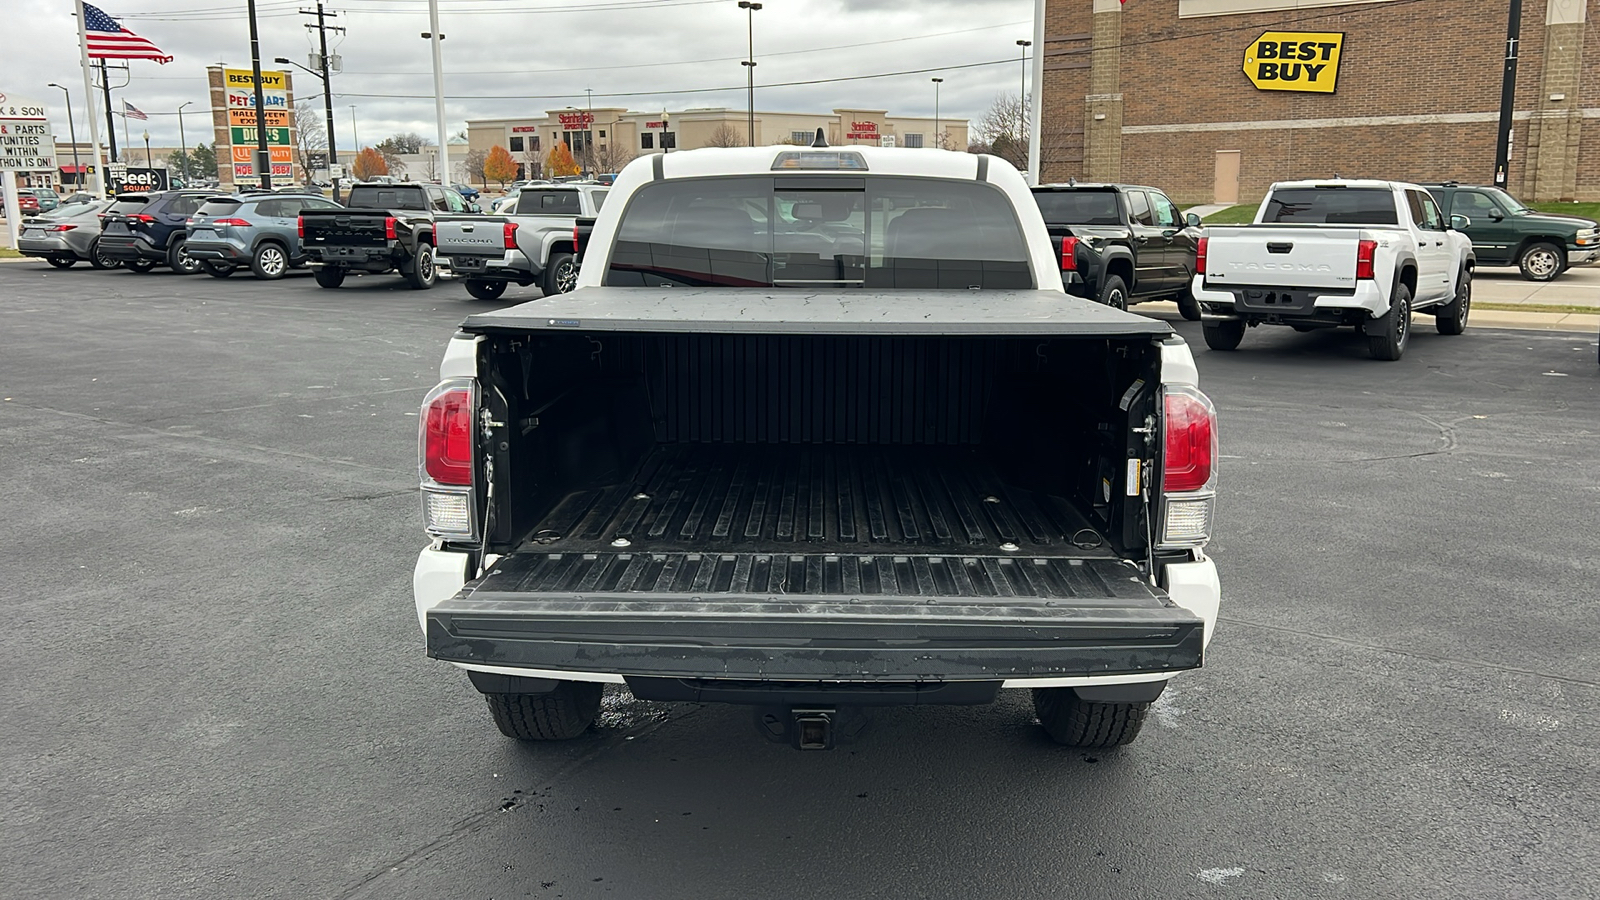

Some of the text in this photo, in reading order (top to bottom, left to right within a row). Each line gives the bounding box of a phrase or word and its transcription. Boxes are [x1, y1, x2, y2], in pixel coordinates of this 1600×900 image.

[1257, 41, 1337, 61] BEST
[1258, 62, 1327, 82] BUY
[229, 94, 285, 106] PETSART
[9, 107, 17, 115] &
[21, 107, 44, 116] SON
[1, 125, 45, 134] & PARTS
[5, 147, 38, 156] WITHIN
[25, 158, 34, 167] IS
[37, 158, 51, 167] ON!
[1229, 261, 1332, 272] TACOMA
